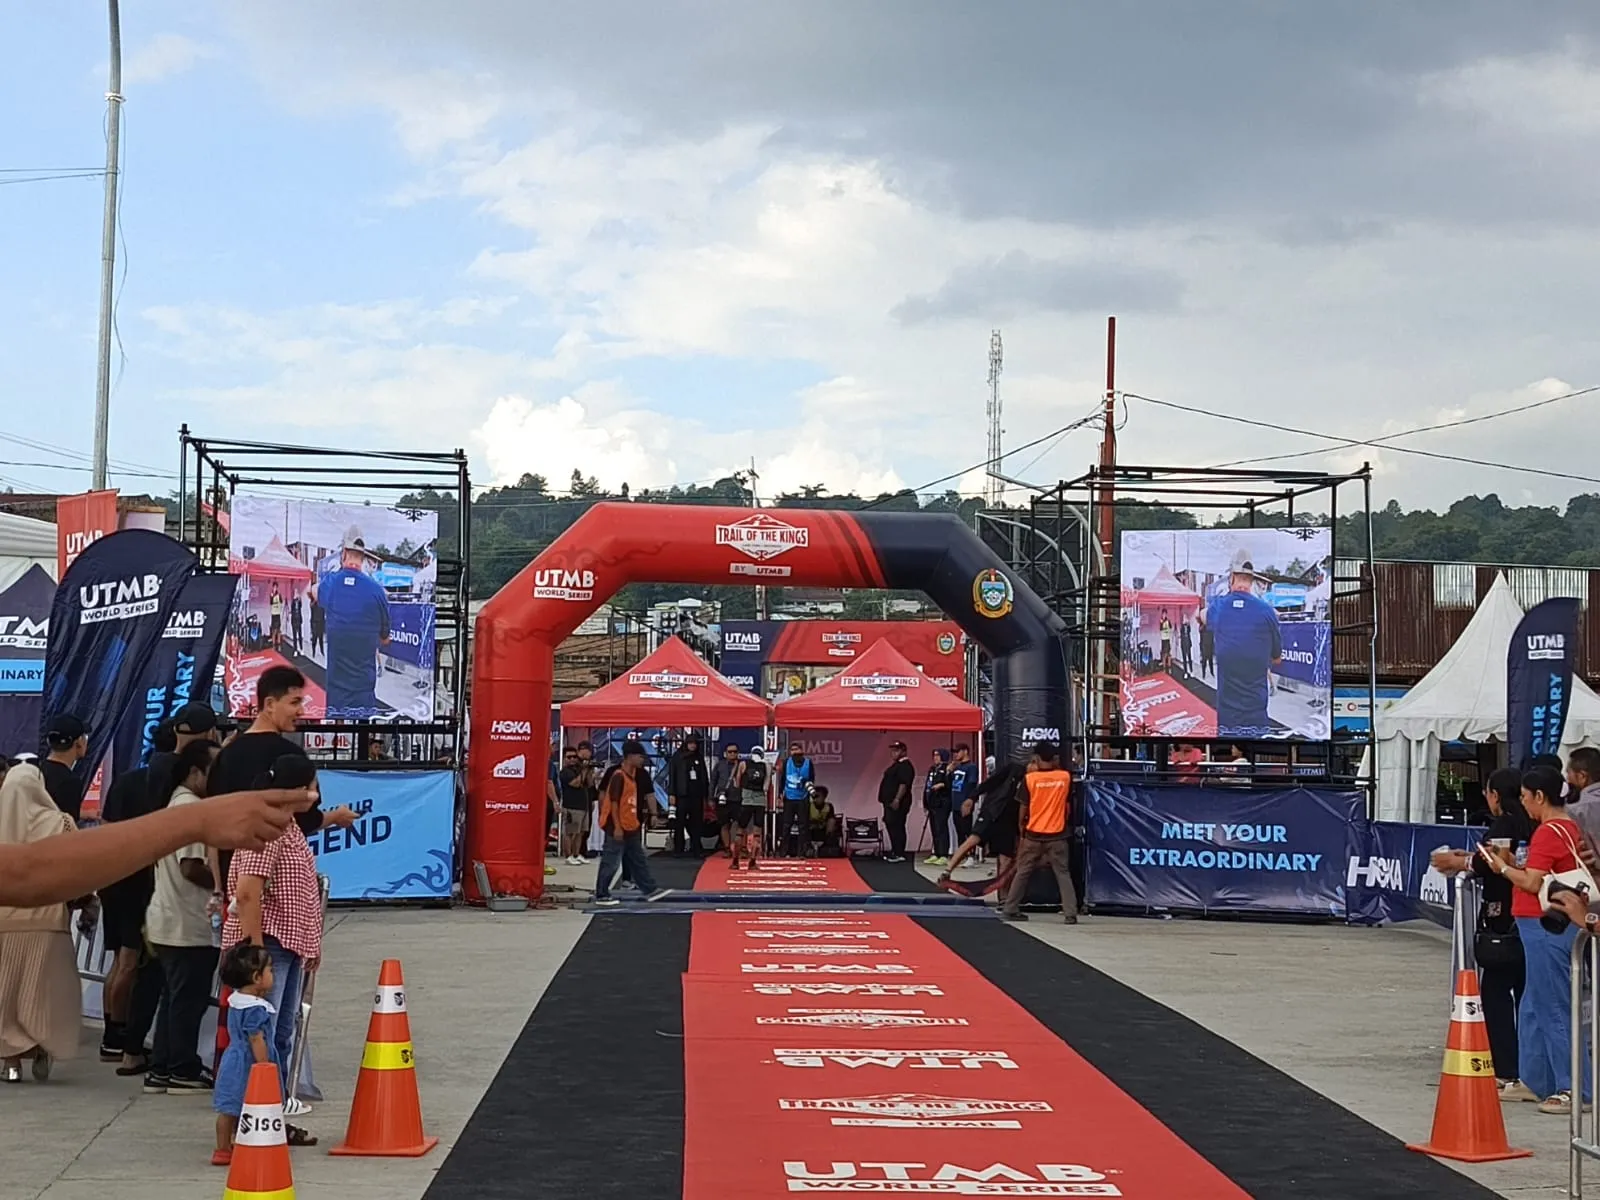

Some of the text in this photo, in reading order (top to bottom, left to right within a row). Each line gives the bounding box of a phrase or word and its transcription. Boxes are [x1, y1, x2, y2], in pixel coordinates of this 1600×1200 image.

[718, 528, 806, 544] TRAIL OF THE KINGS
[535, 569, 594, 588] UTMB
[80, 574, 160, 609] UTMB
[537, 589, 590, 599] WORLD SERIES
[83, 602, 155, 621] WORLD SERIES
[725, 632, 761, 644] UTMB
[1528, 634, 1564, 650] UTMB
[632, 675, 652, 683] TRAIL
[683, 676, 706, 684] KINGS
[895, 678, 918, 686] KINGS
[491, 720, 531, 734] HOKA
[1022, 727, 1060, 741] HOKA
[1531, 704, 1546, 758] OUR
[1161, 822, 1288, 843] MEET YOUR
[1129, 848, 1323, 872] EXTRAORDINARY
[1347, 855, 1403, 891] HOKA
[776, 1056, 1019, 1069] UTMB
[787, 1099, 861, 1108] TRAIL
[966, 1102, 1046, 1111] KINGS
[255, 1118, 282, 1132] ISG
[784, 1161, 1106, 1181] UTMB
[803, 1181, 1106, 1193] WORLD SERIES
